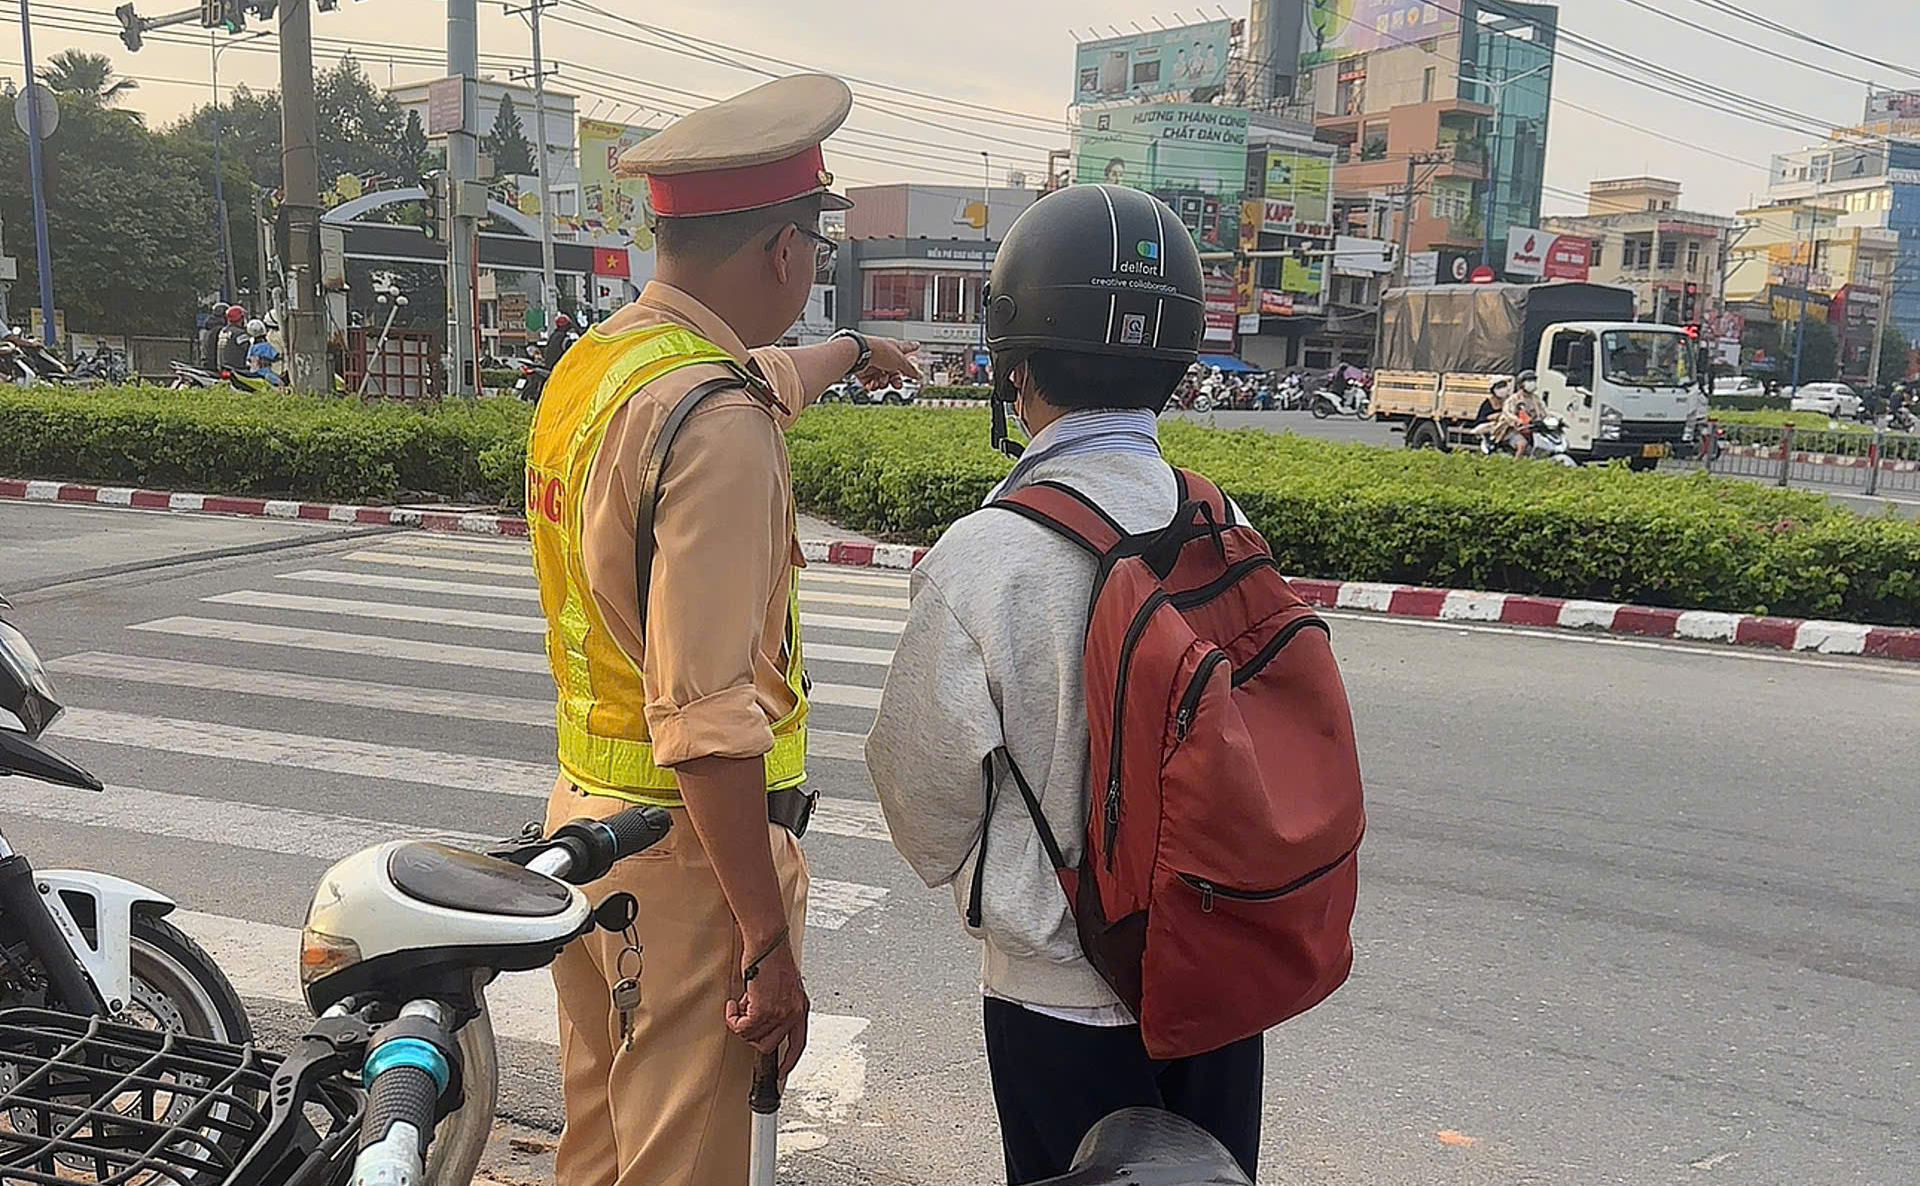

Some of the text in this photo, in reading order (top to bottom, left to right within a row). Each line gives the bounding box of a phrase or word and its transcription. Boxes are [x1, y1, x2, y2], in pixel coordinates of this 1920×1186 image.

[1219, 114, 1246, 129] CÔNG
[1163, 124, 1245, 145] CHẤT ĐÀN ÔNG
[1120, 260, 1158, 276] delfort
[1091, 278, 1177, 294] creative collaboration
